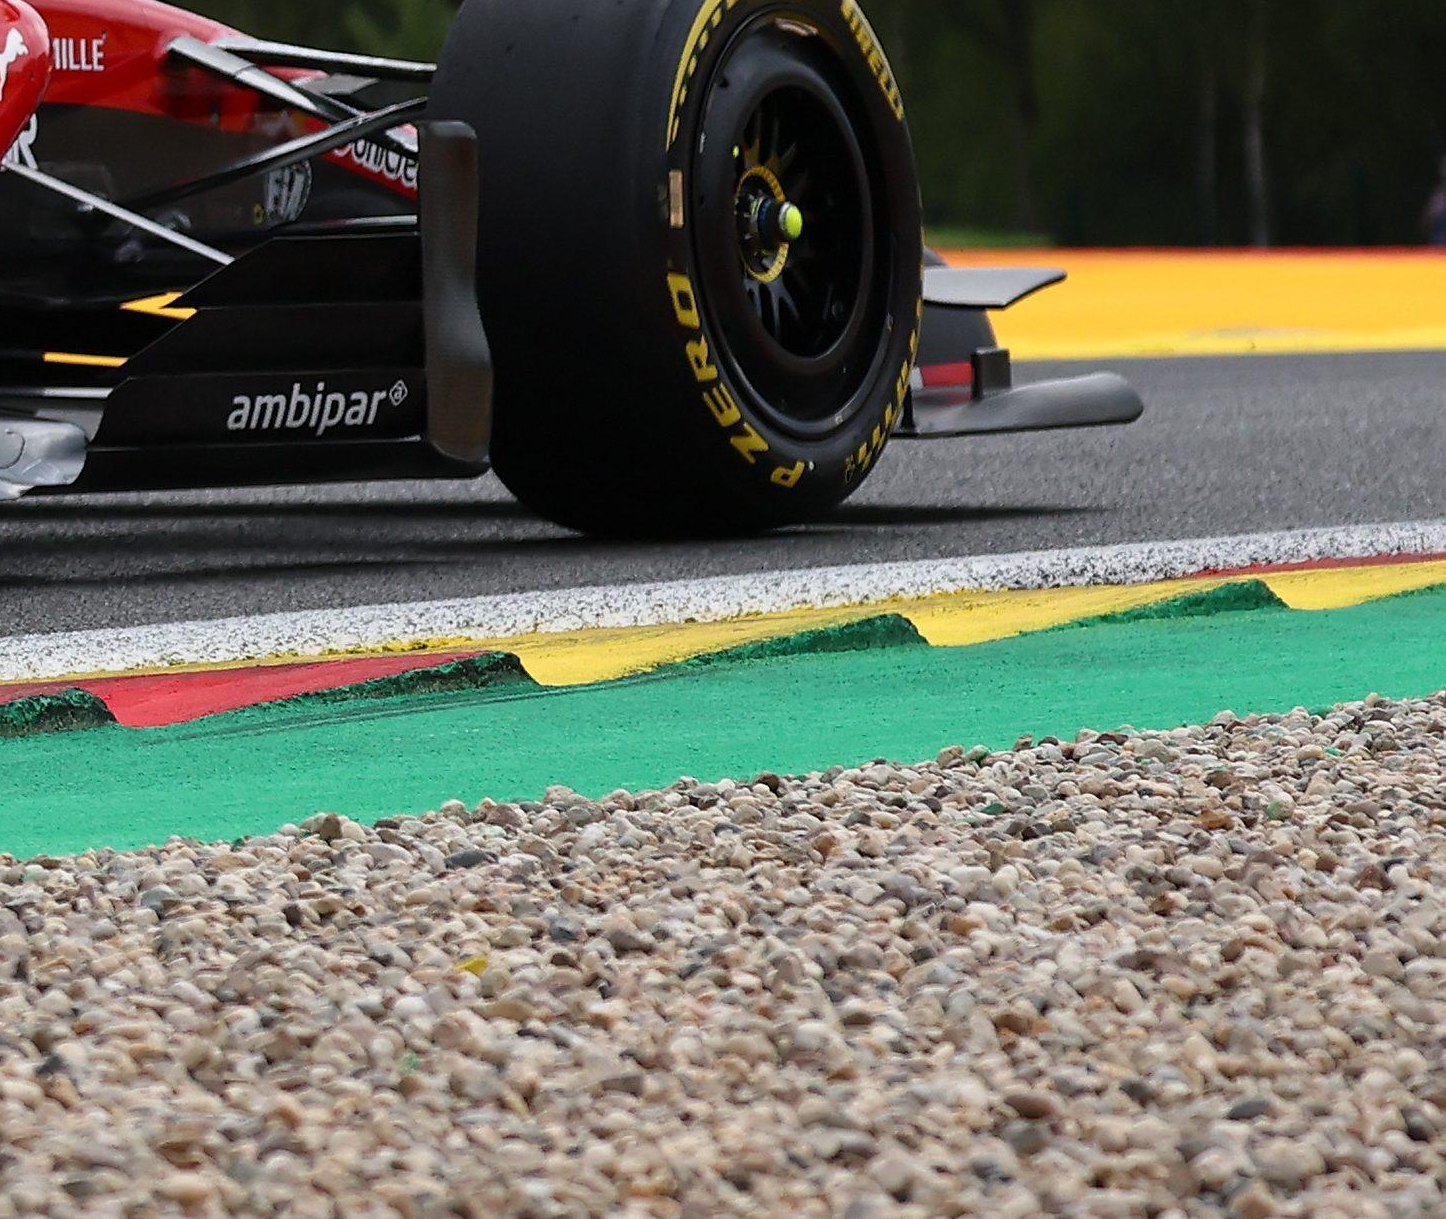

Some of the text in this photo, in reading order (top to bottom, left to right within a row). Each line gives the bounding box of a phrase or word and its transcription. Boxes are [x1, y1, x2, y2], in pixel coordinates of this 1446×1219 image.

[226, 382, 388, 437] ambipar
[666, 271, 806, 489] P ZERO
